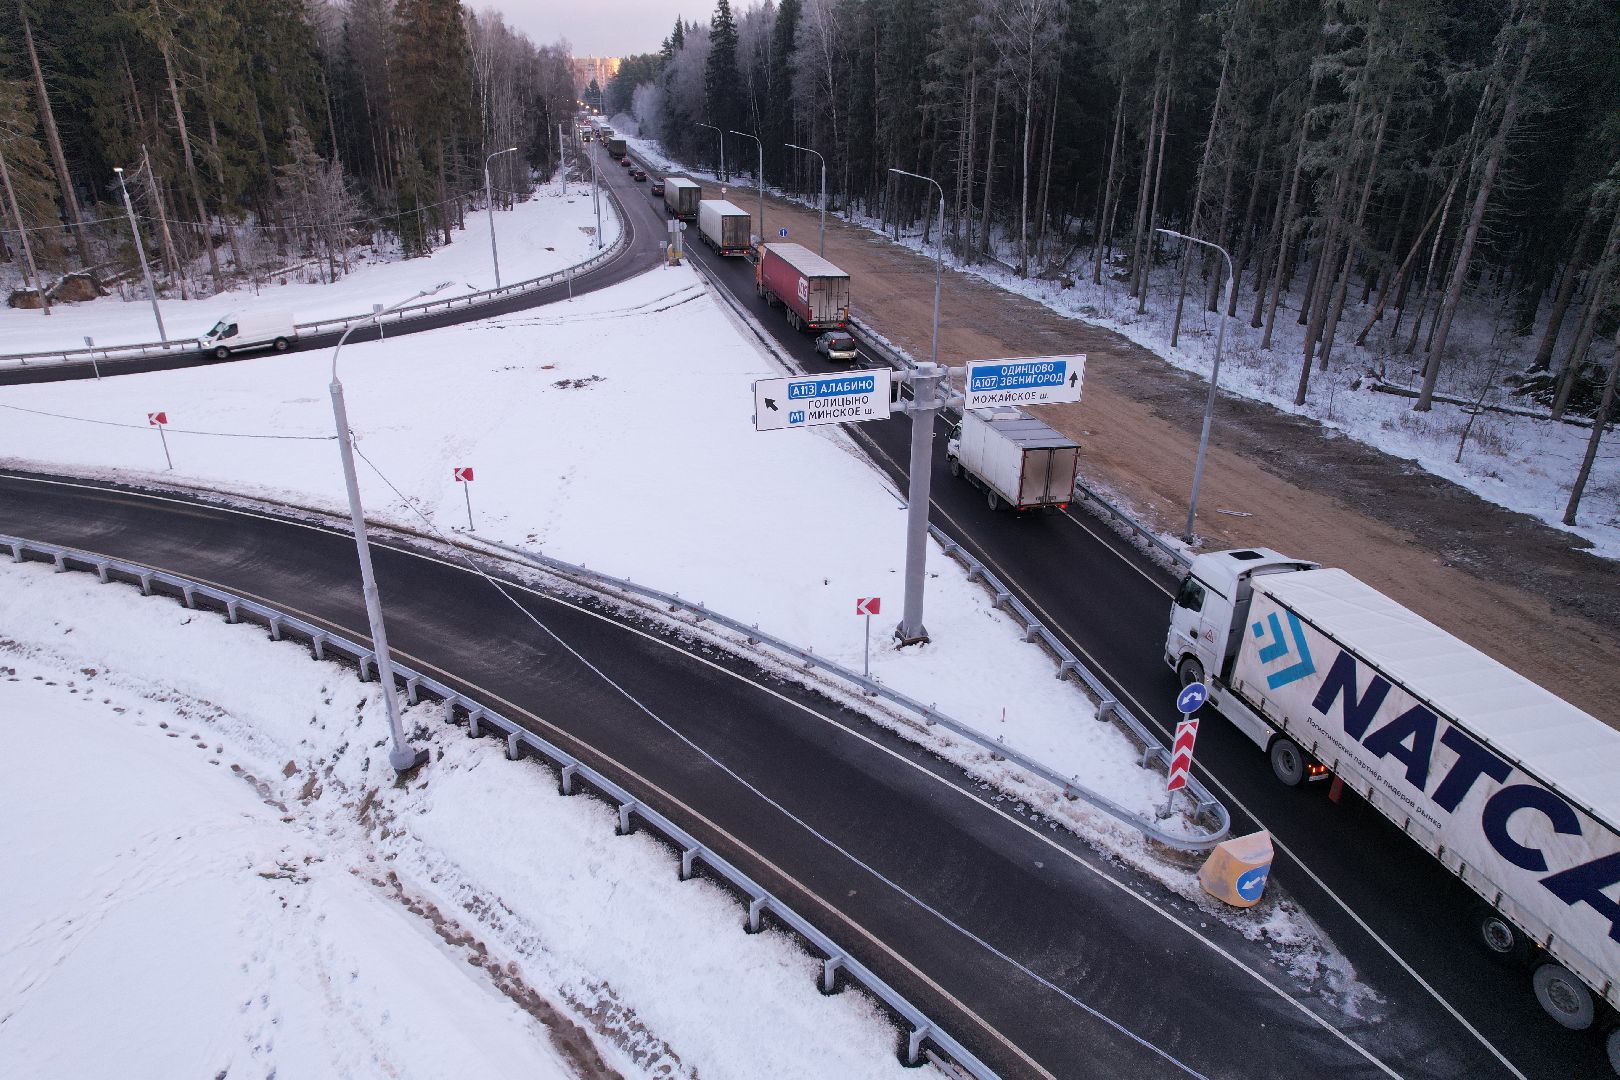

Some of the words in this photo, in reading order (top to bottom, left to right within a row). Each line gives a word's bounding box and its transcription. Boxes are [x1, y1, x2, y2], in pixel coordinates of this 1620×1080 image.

[1001, 363, 1054, 376] ОДИНЦОВО
[1000, 373, 1063, 386] ЗВЕНИГОРОД
[820, 380, 873, 394] АЛАБИНО
[808, 396, 869, 410] ГОЛИЦЫНО
[972, 391, 1037, 404] МОЖАЙСКОЕ
[808, 408, 861, 421] МИНСКОЕ
[1306, 716, 1353, 758] Логистический
[1383, 779, 1416, 808] лидеров
[1416, 806, 1442, 829] рынка
